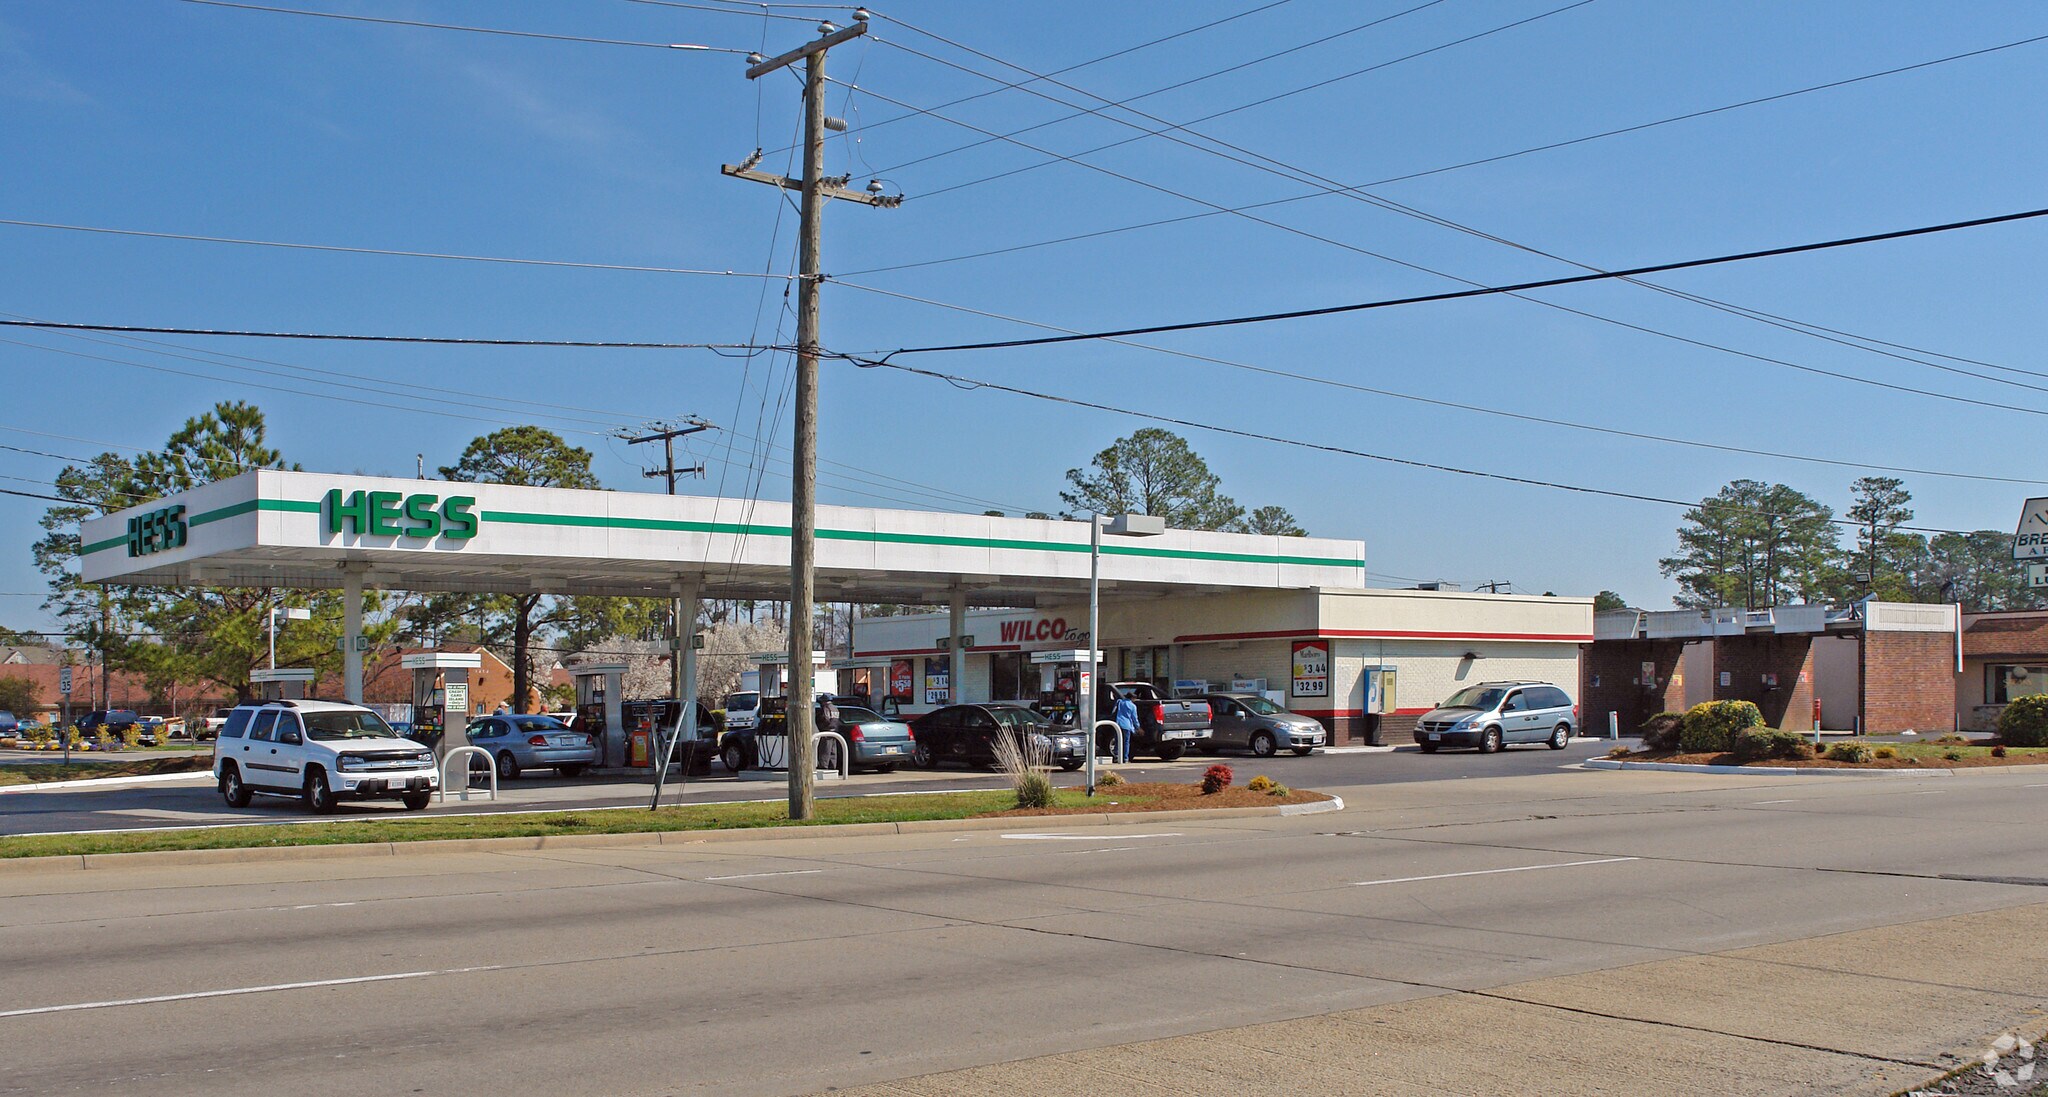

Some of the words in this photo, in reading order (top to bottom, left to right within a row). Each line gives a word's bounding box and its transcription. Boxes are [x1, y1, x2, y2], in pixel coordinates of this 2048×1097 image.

[330, 489, 478, 539] HESS
[128, 505, 187, 557] HESS
[1001, 617, 1066, 642] WILCO
[413, 656, 426, 665] HESS
[762, 653, 778, 661] HESS
[1304, 663, 1326, 674] $3.44
[62, 680, 72, 691] 35
[1296, 681, 1324, 691] $32.99
